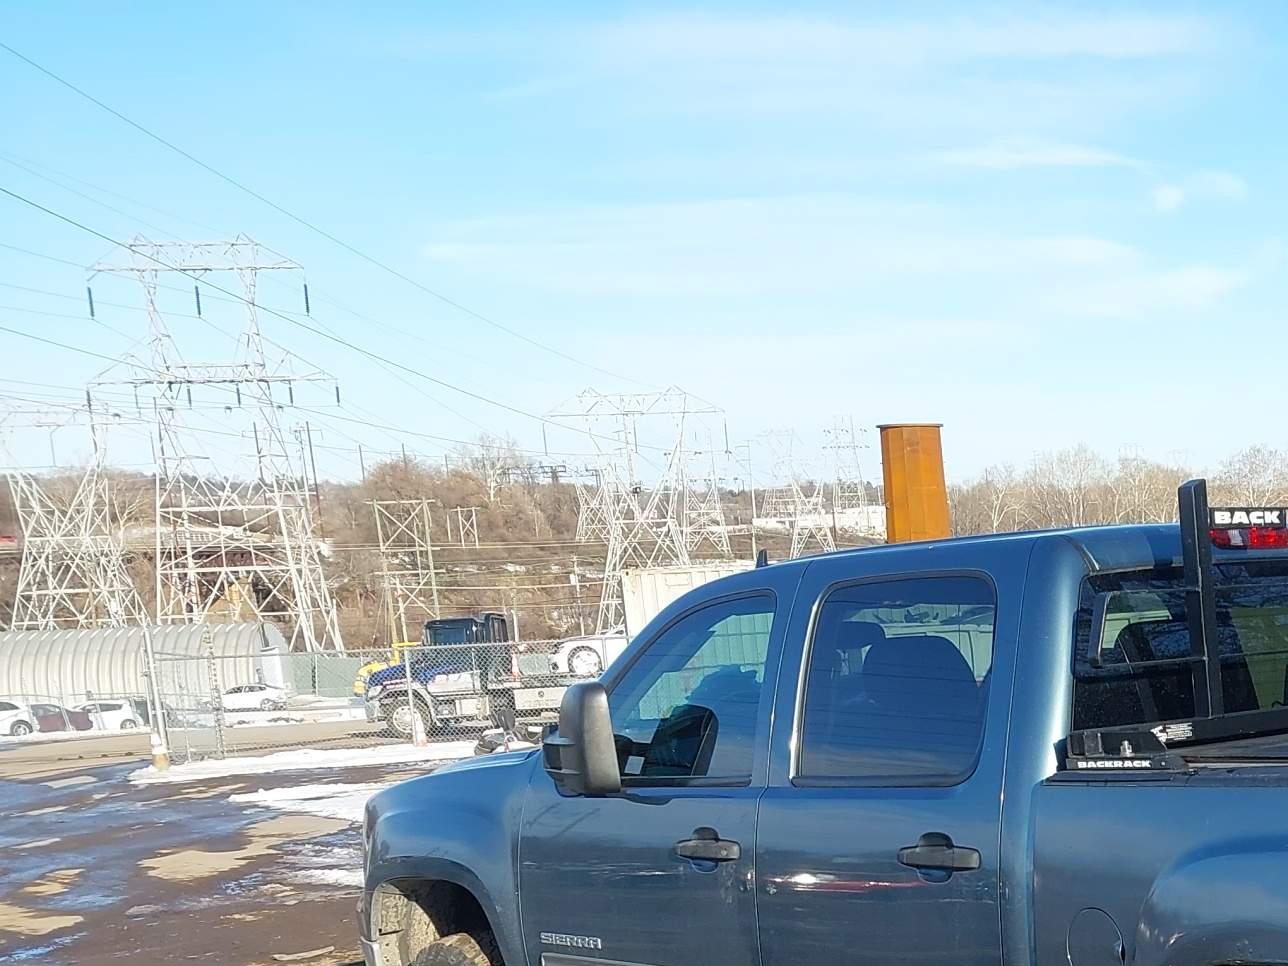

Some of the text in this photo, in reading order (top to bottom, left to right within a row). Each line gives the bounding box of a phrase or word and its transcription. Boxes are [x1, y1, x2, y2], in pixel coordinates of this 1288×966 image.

[1214, 510, 1281, 525] BACK
[1077, 760, 1152, 769] BACKRACK
[540, 932, 602, 949] SIERRA
